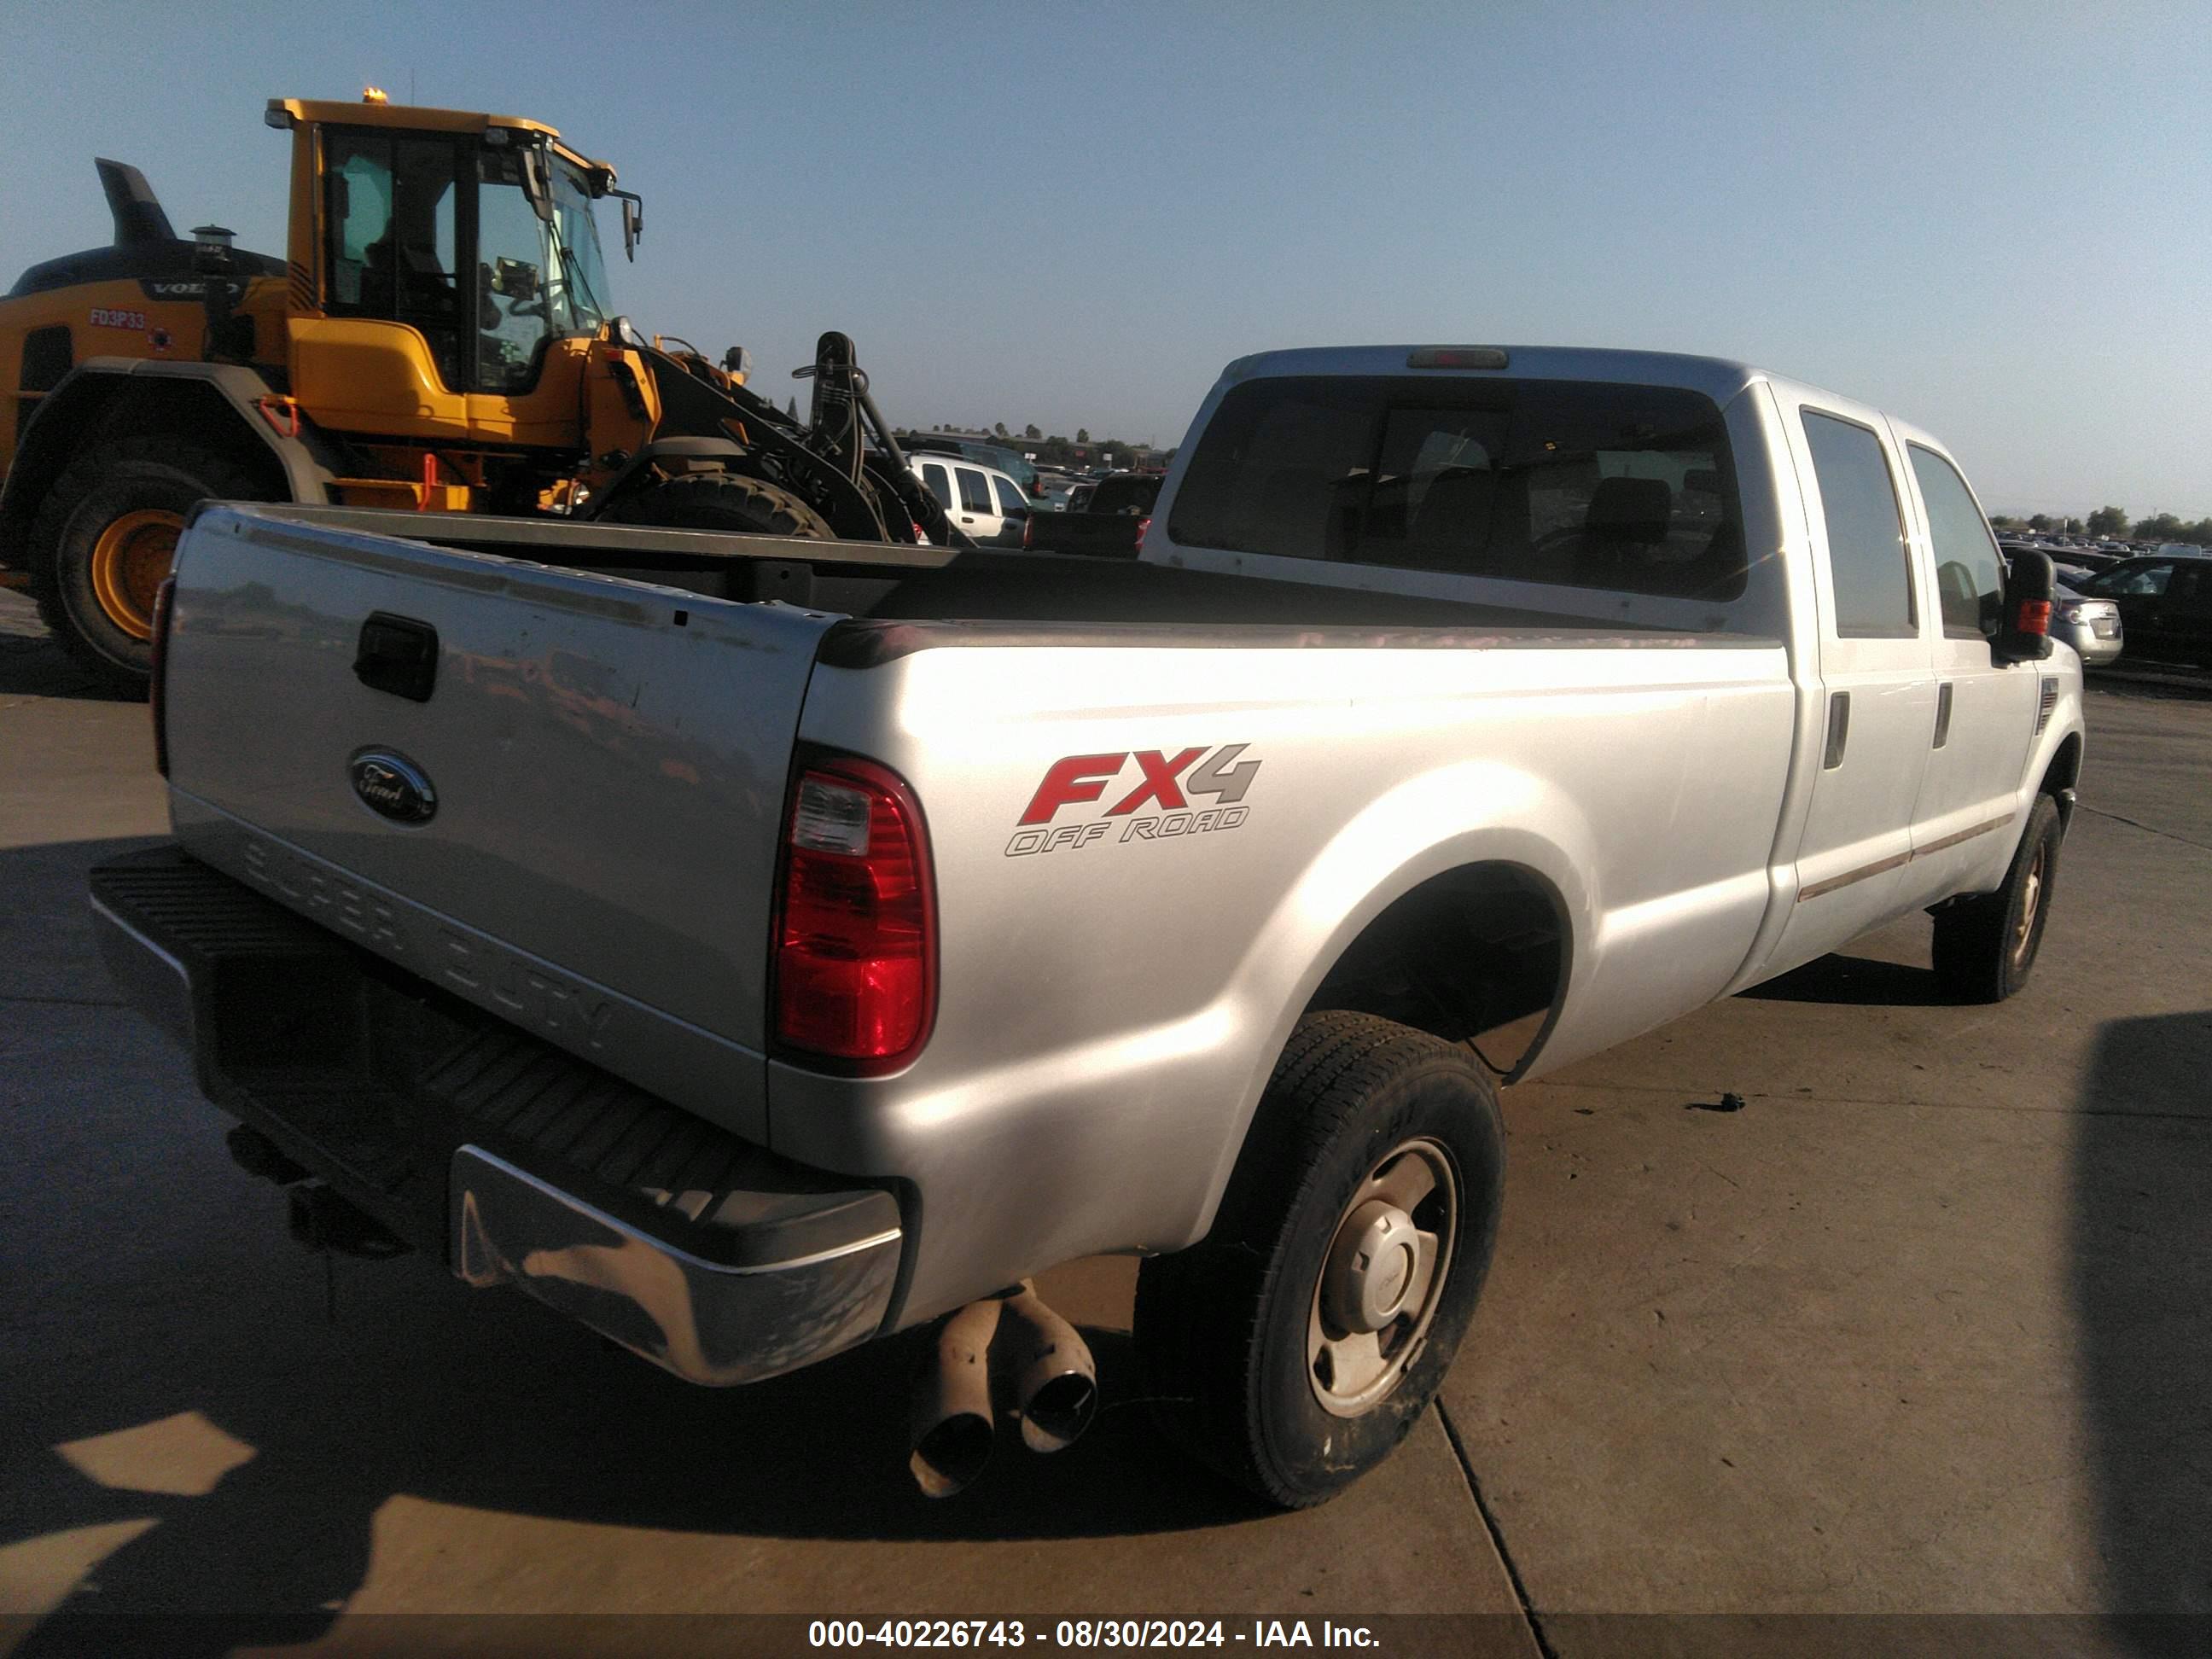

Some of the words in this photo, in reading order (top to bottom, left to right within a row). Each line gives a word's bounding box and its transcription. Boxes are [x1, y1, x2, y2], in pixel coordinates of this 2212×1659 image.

[154, 282, 241, 294] VOLO
[90, 308, 145, 329] FD3P33
[359, 765, 404, 800] Ford
[1016, 742, 1262, 826] FX4
[1004, 821, 1112, 857] OFF
[1118, 806, 1250, 843] ROAD
[245, 843, 405, 950] SUPER
[438, 928, 613, 1048] DUTY
